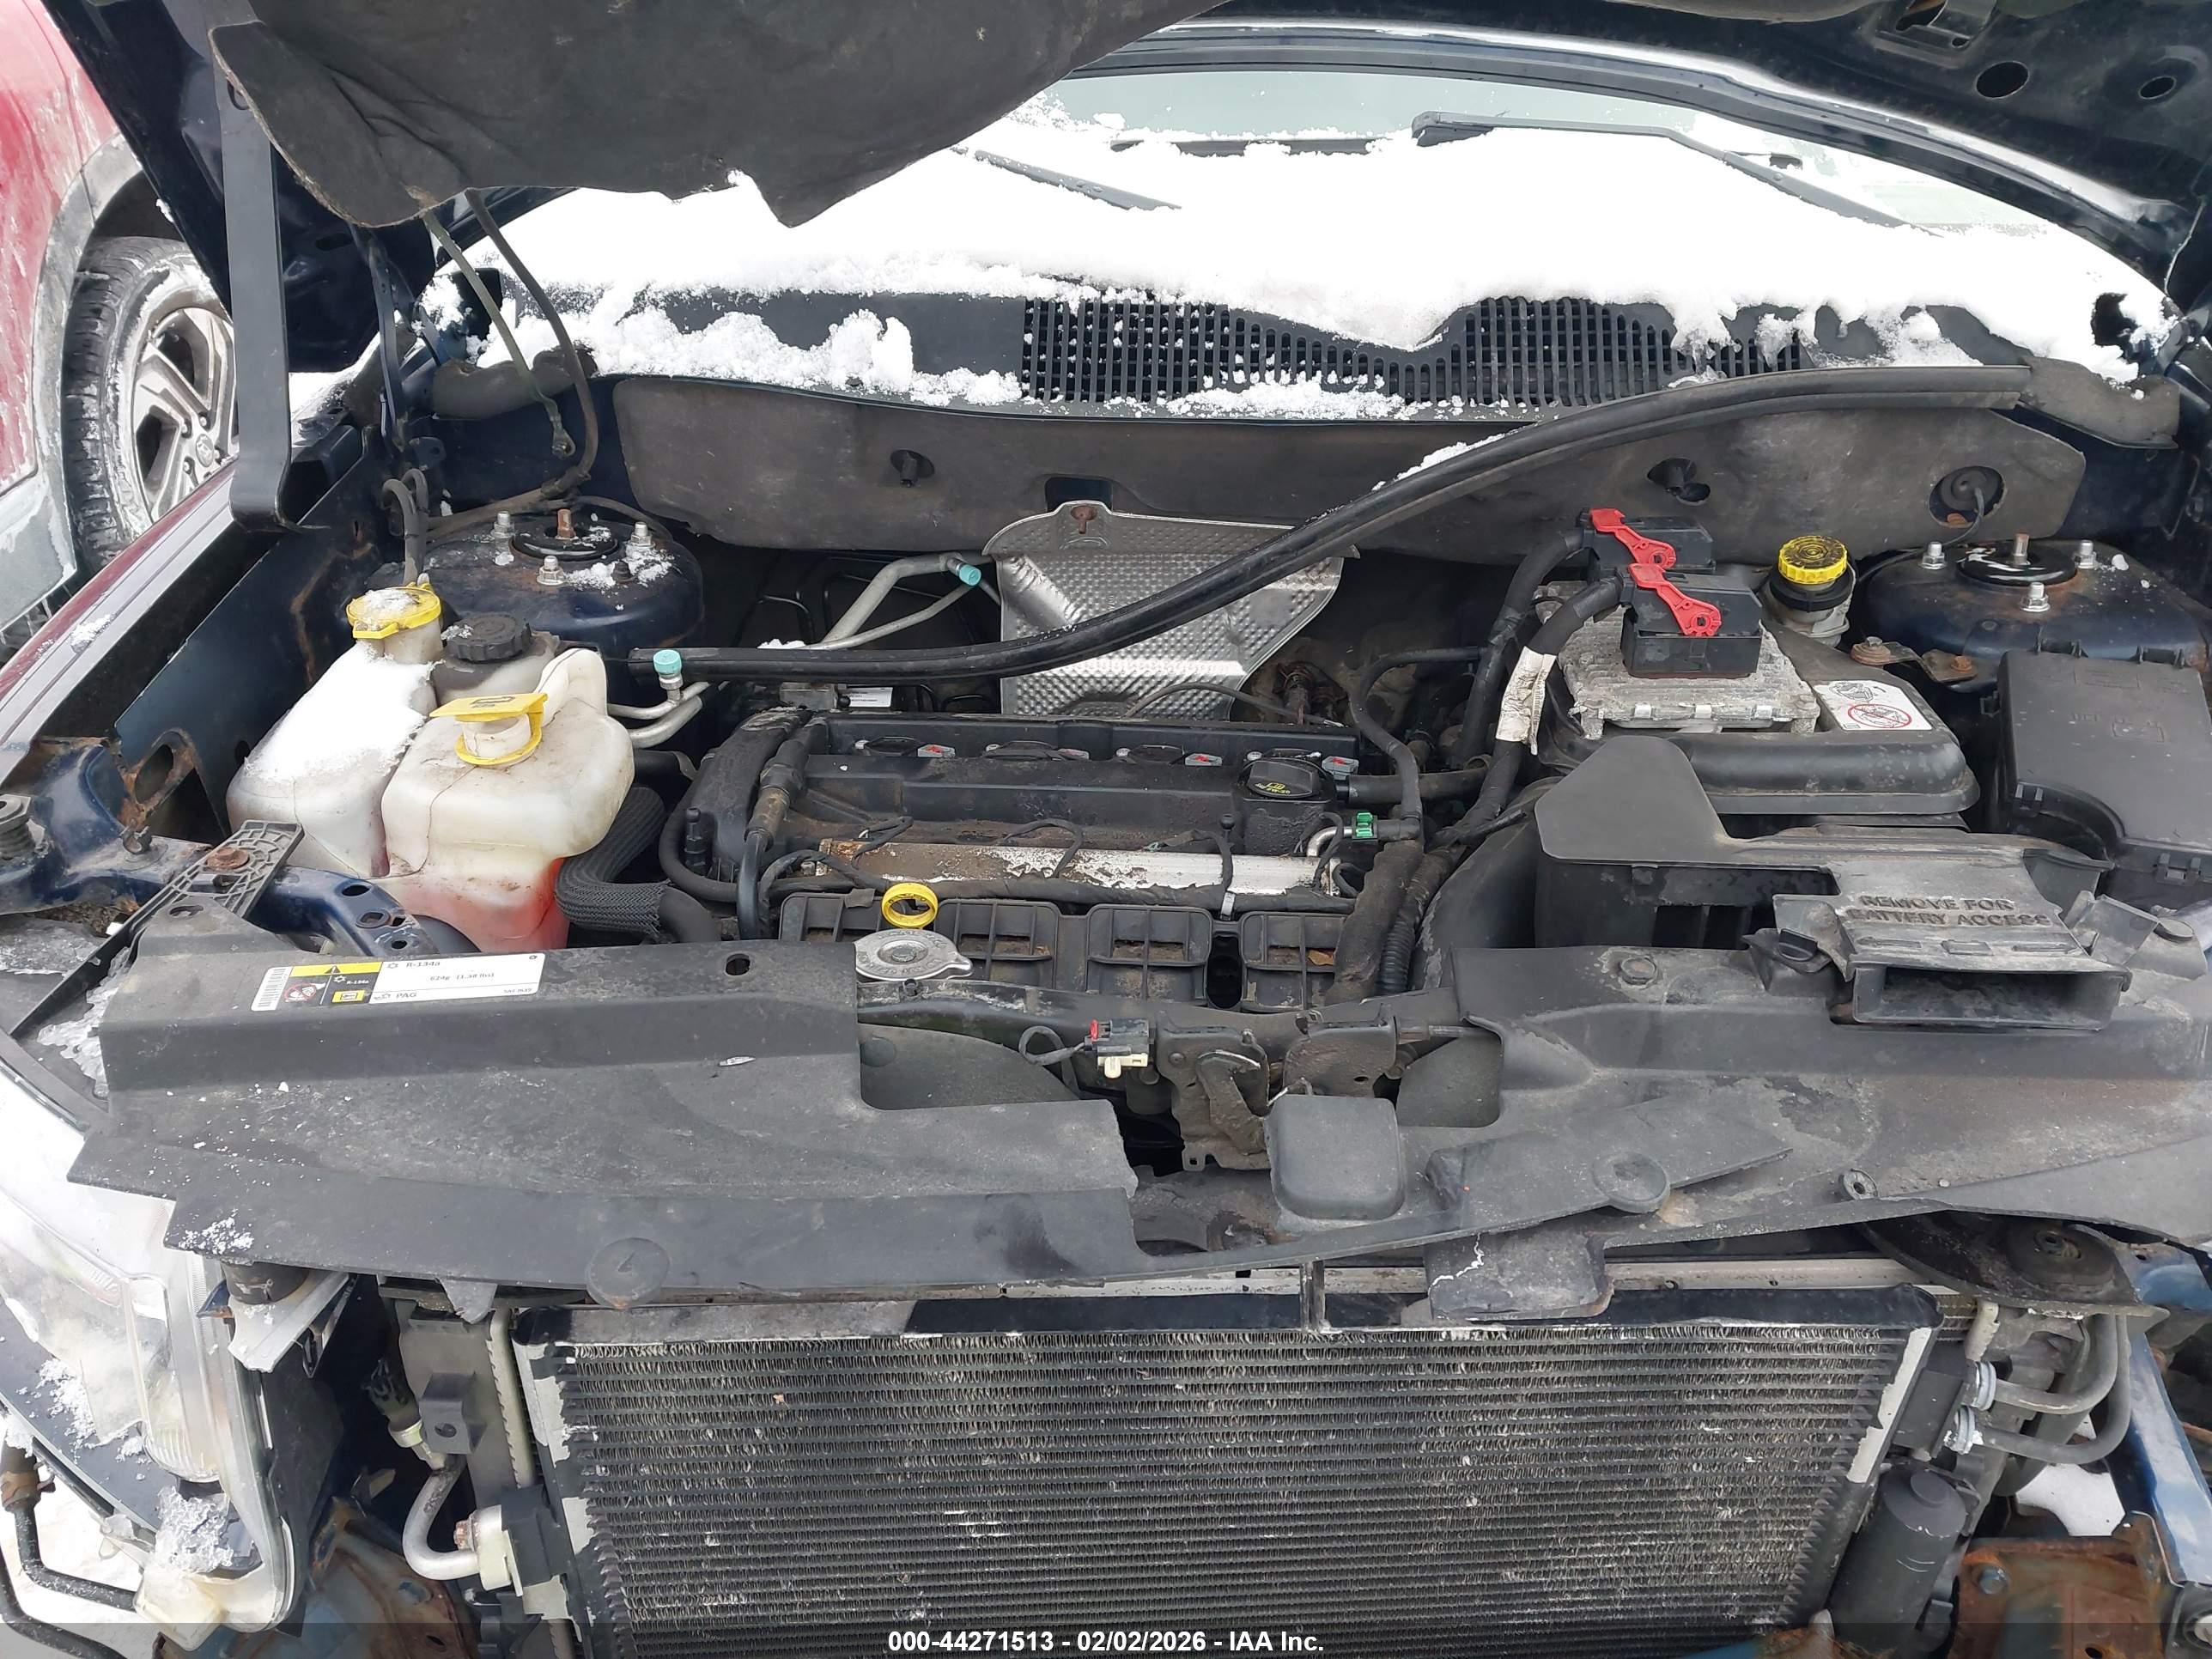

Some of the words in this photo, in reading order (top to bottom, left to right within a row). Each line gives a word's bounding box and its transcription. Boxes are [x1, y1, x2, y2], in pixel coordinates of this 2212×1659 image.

[1858, 895, 1959, 911] REMOVE
[1963, 897, 2015, 911] FOR
[1845, 908, 1948, 926] BATTERY
[1957, 913, 2051, 927] ACCESS
